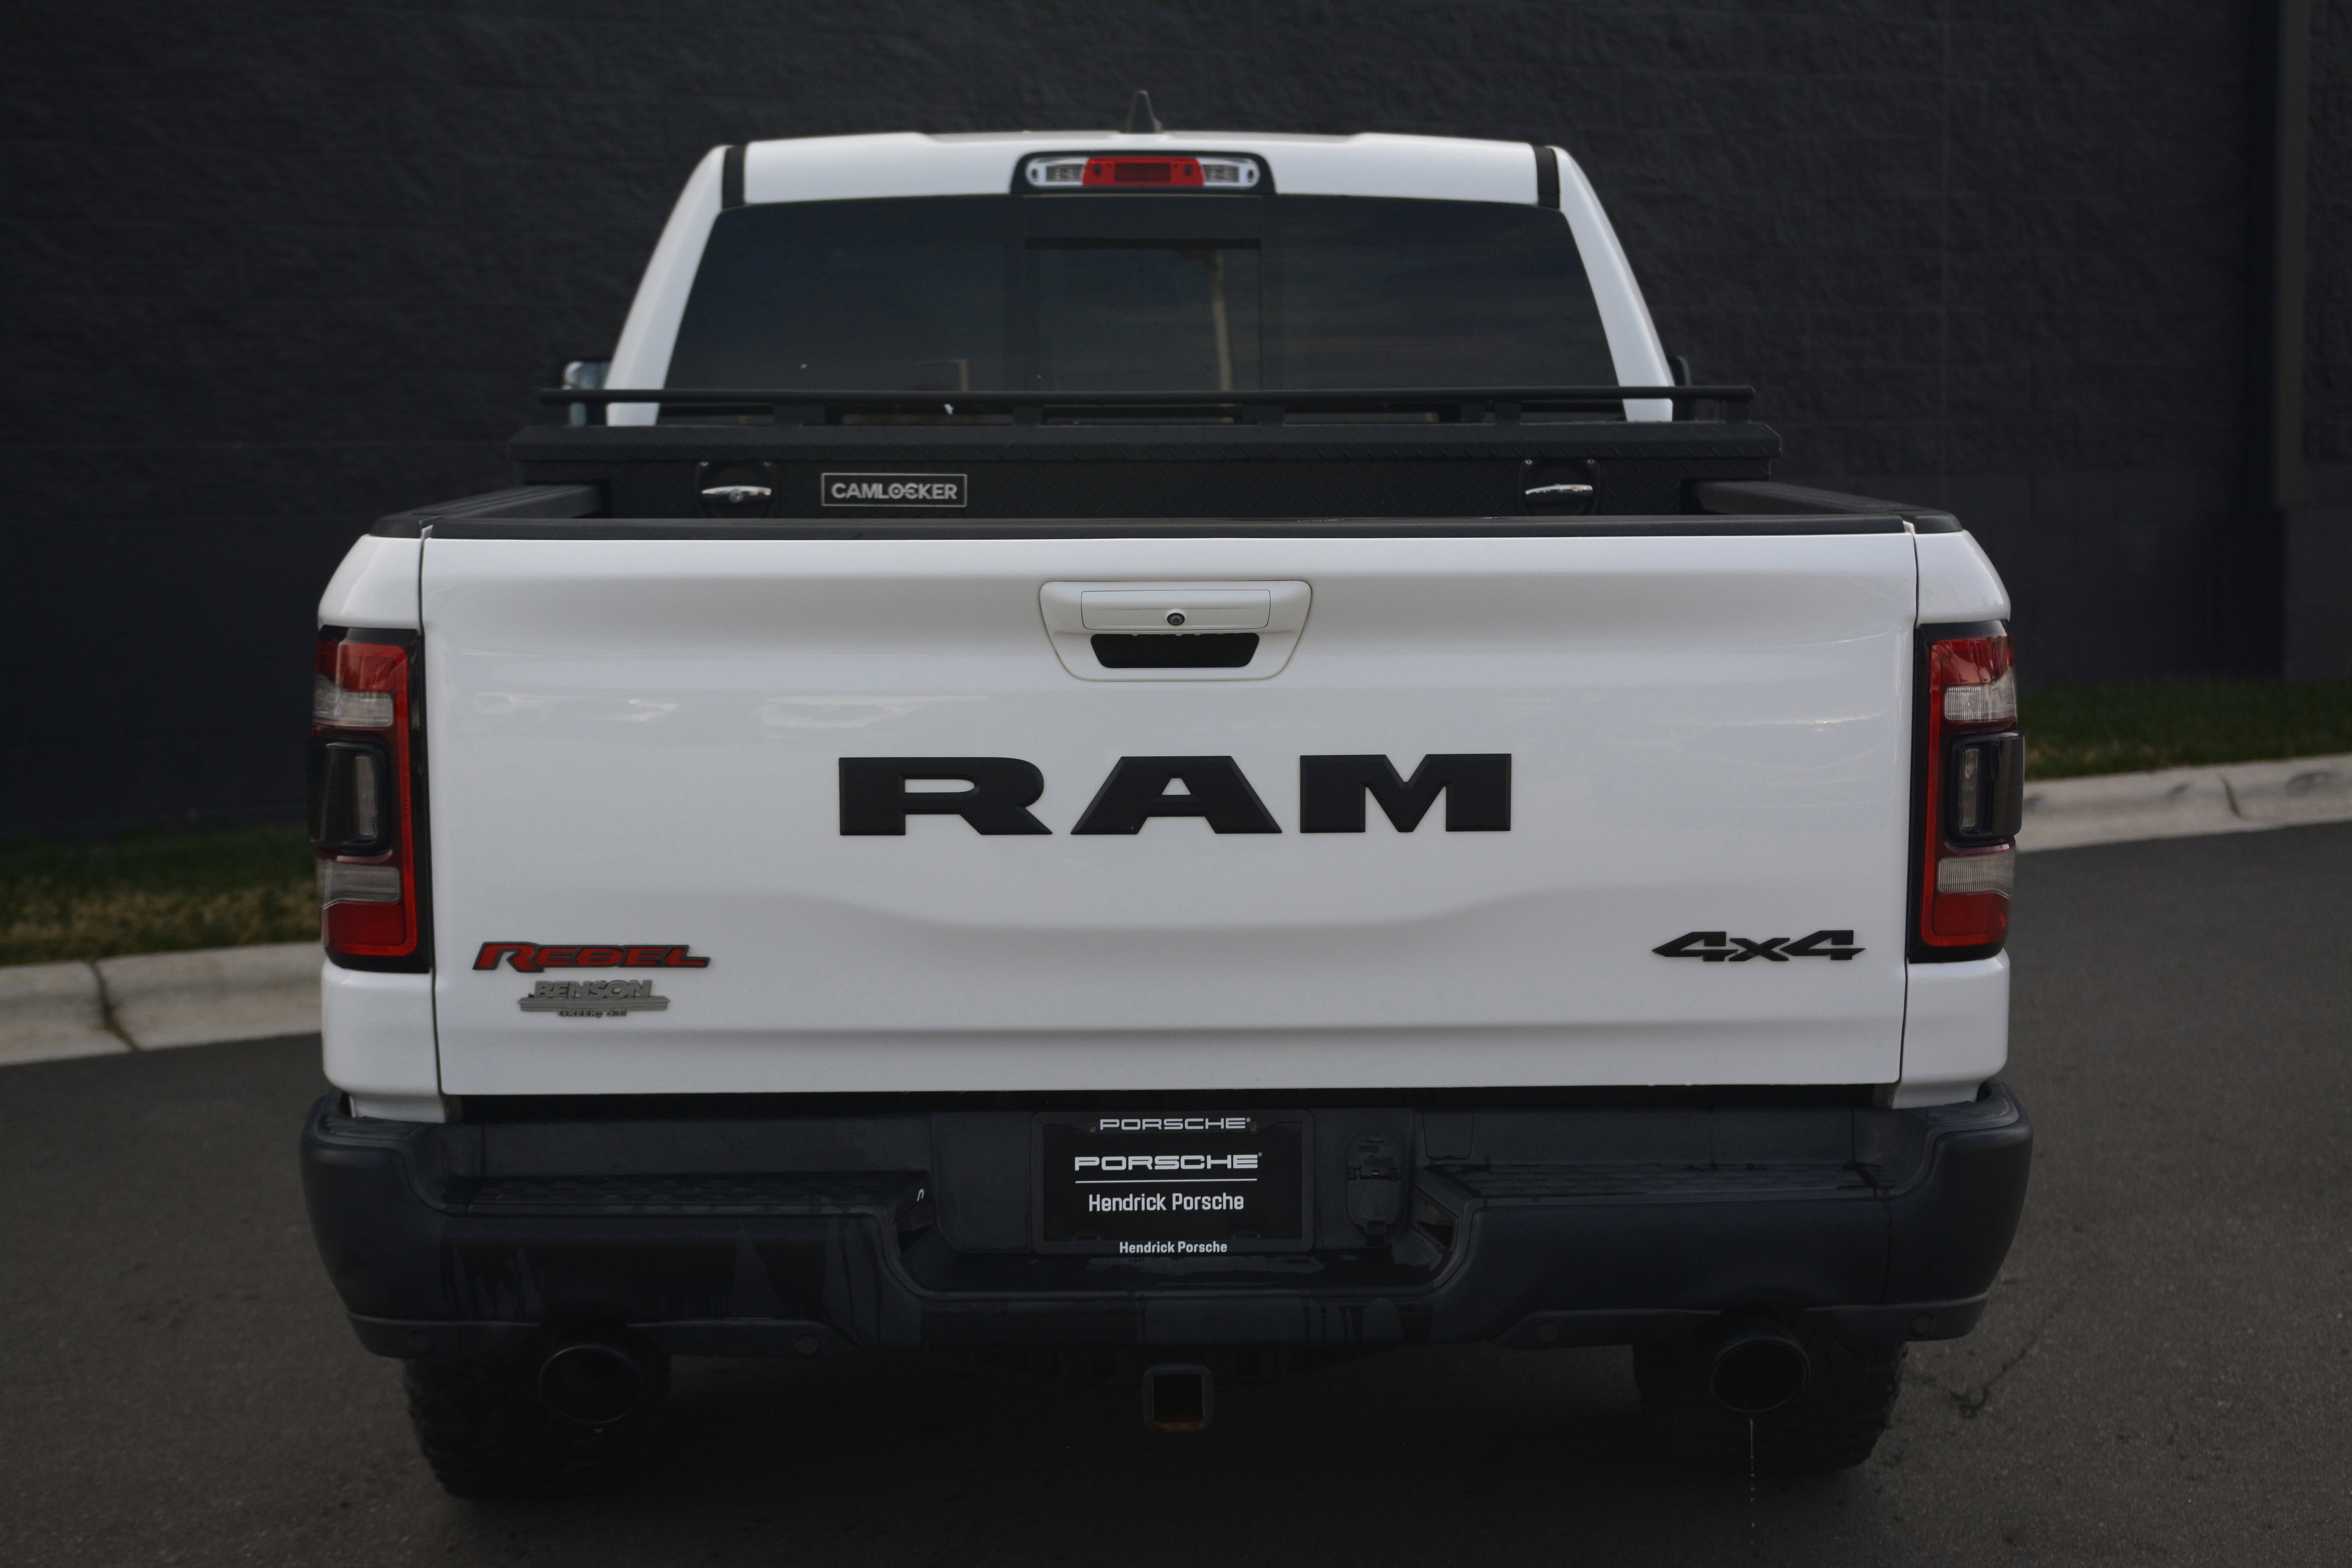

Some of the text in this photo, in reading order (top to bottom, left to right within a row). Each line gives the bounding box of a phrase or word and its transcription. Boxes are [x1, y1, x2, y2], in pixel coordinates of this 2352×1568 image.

[831, 482, 958, 500] CAMLOCKER
[839, 753, 1512, 836] RAM
[1651, 929, 1866, 962] 4x4
[472, 941, 711, 973] REBEL
[534, 980, 653, 999] BENSON
[1089, 1192, 1244, 1212] Hendrick Porsche
[1119, 1241, 1228, 1254] Hendrick Porsche
